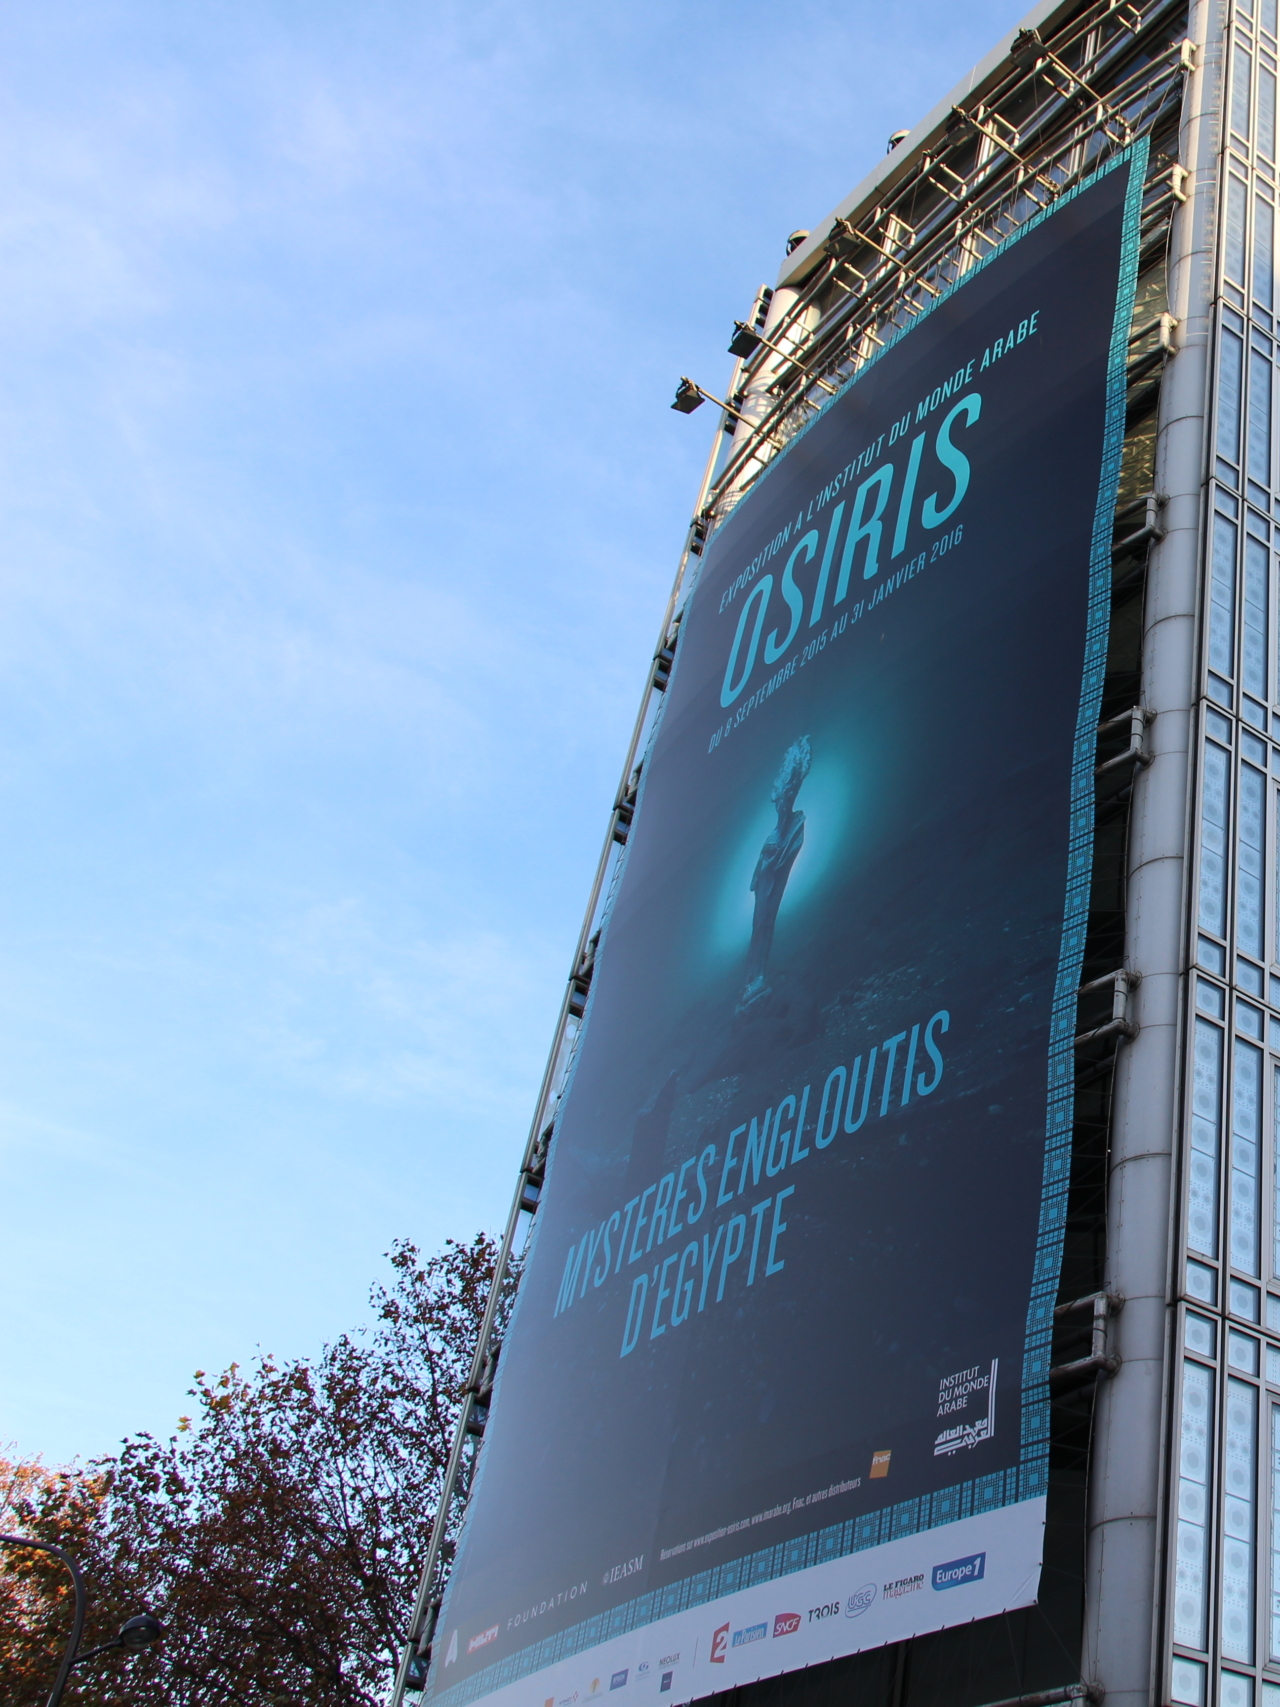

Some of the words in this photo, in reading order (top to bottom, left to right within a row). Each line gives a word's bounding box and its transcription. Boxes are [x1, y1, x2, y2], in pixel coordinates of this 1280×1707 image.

[719, 522, 792, 614] EXPOSITION
[793, 510, 803, 535] A
[806, 433, 885, 522] L'INSTITUT
[888, 411, 911, 447] DU
[915, 358, 975, 424] MONDE
[979, 310, 1040, 372] ARABE
[720, 392, 982, 708] OSIRIS
[708, 726, 723, 754] DU
[724, 717, 733, 737] 8
[734, 654, 799, 728] SEPTEMBRE
[800, 628, 828, 667] 2015
[830, 612, 848, 641] AU
[851, 599, 865, 624] 31
[868, 551, 926, 610] JANVIER
[930, 524, 963, 563] 2016
[553, 1143, 716, 1319] MYSTERES
[715, 1009, 950, 1209] ENGLOUTIS
[619, 1184, 795, 1359] D'EGYPTE
[938, 1388, 952, 1404] DU
[953, 1375, 989, 1398] MONDE
[939, 1365, 980, 1390] INSTITUT
[936, 1395, 968, 1417] ARABE
[872, 1453, 891, 1465] fnac
[806, 1493, 812, 1505] et
[812, 1488, 828, 1503] autres
[828, 1477, 861, 1497] distributeurs
[883, 1582, 893, 1592] LE
[895, 1573, 924, 1588] FIGARO
[936, 1564, 972, 1584] Europe
[973, 1557, 982, 1576] 1
[847, 1590, 871, 1609] UGC
[883, 1581, 924, 1600] magazine
[507, 1581, 588, 1631] FOUNDATION
[468, 1625, 499, 1653] HILTI
[774, 1617, 800, 1635] SNCF
[714, 1630, 729, 1659] 2
[659, 1652, 681, 1666] NEOLUX
